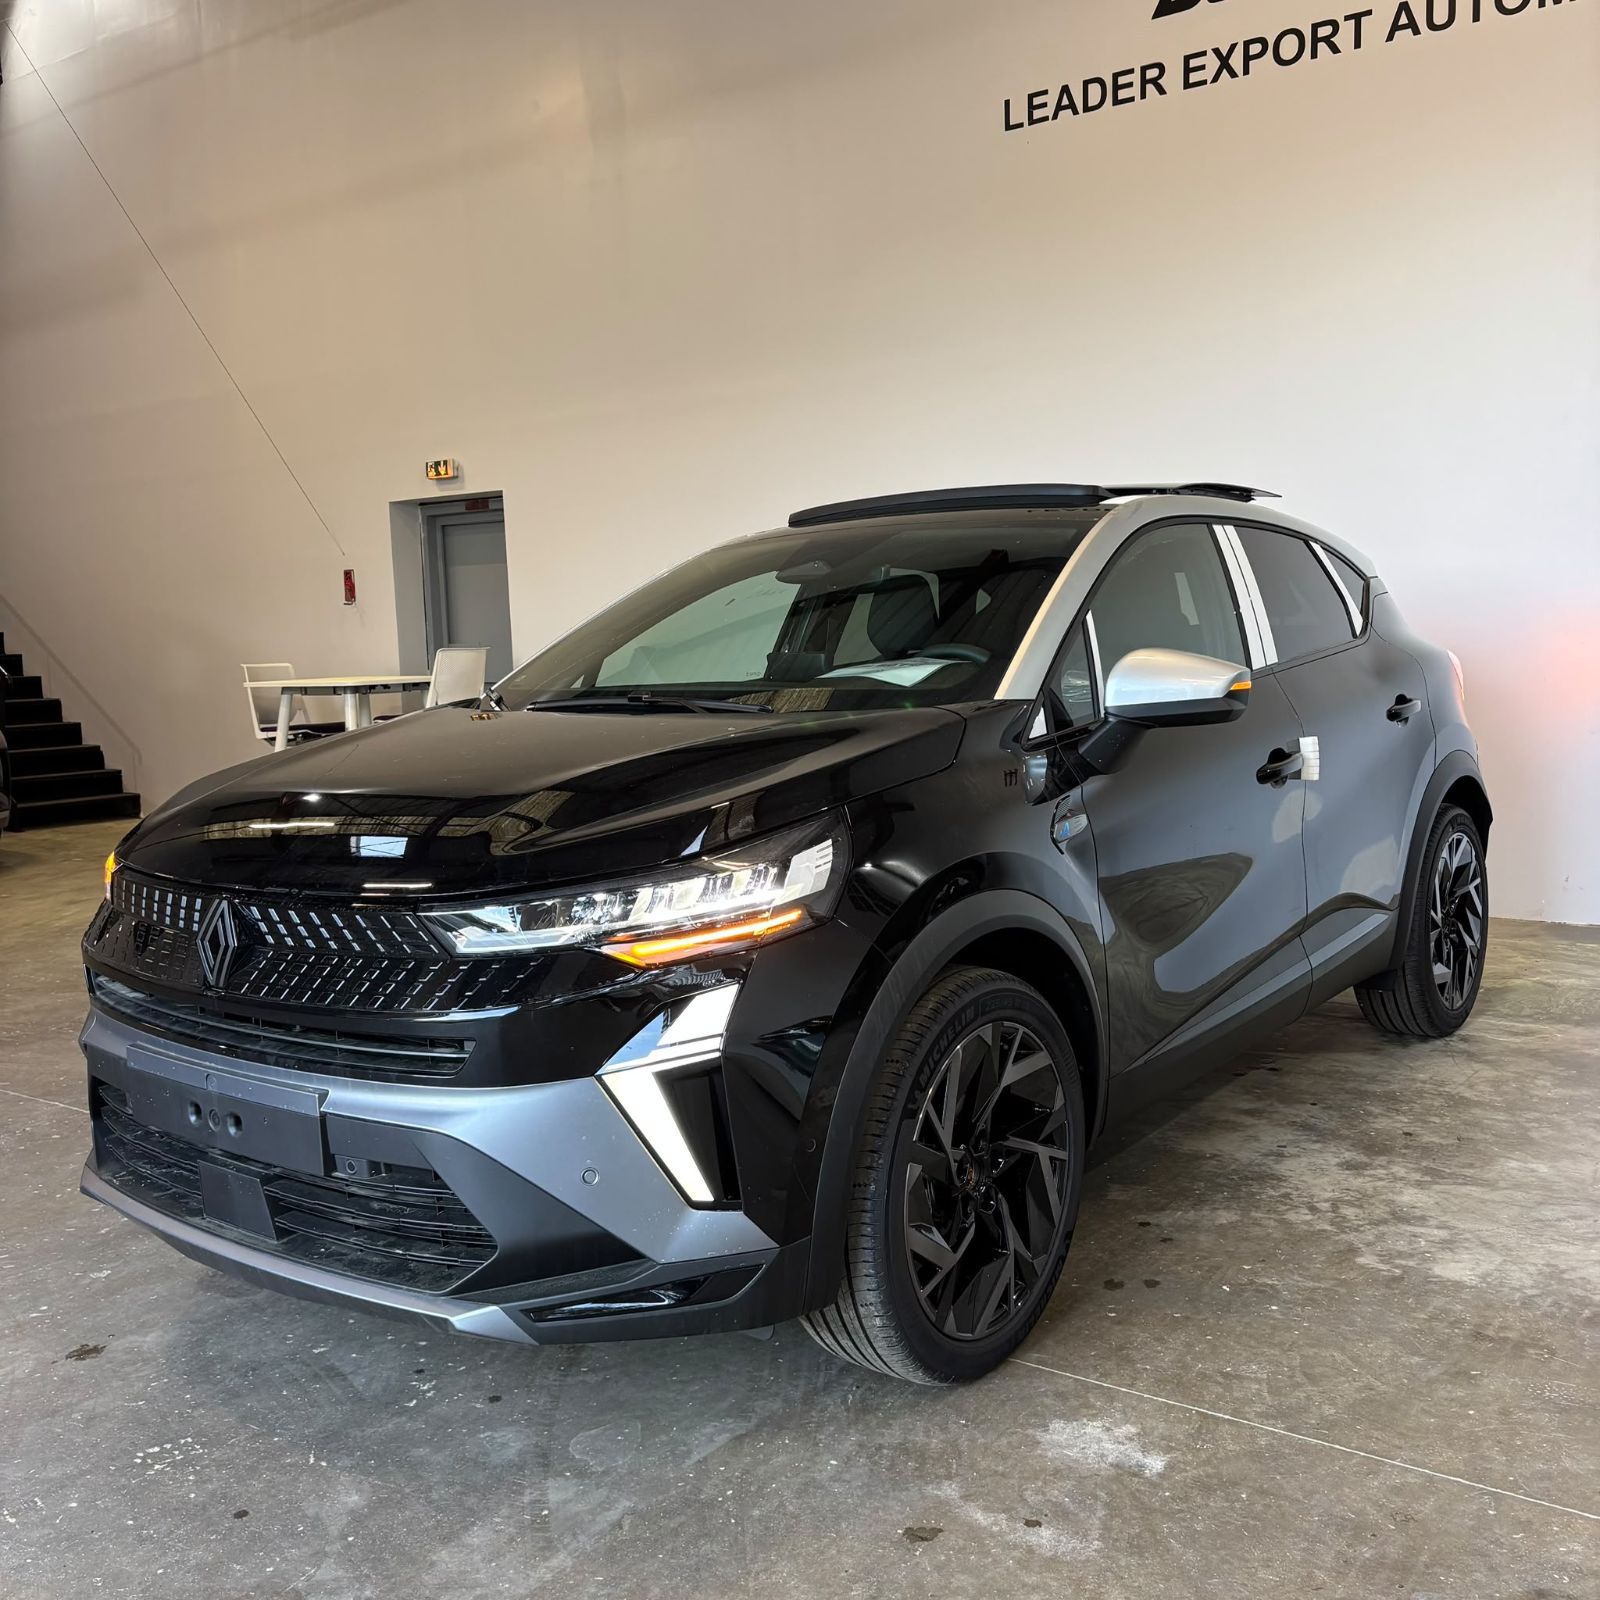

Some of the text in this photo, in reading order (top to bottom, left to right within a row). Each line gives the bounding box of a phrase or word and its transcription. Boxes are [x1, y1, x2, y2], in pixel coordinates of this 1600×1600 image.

[1003, 0, 1577, 132] LEADER EXPORT AUT
[918, 1005, 976, 1088] MICHELIN
